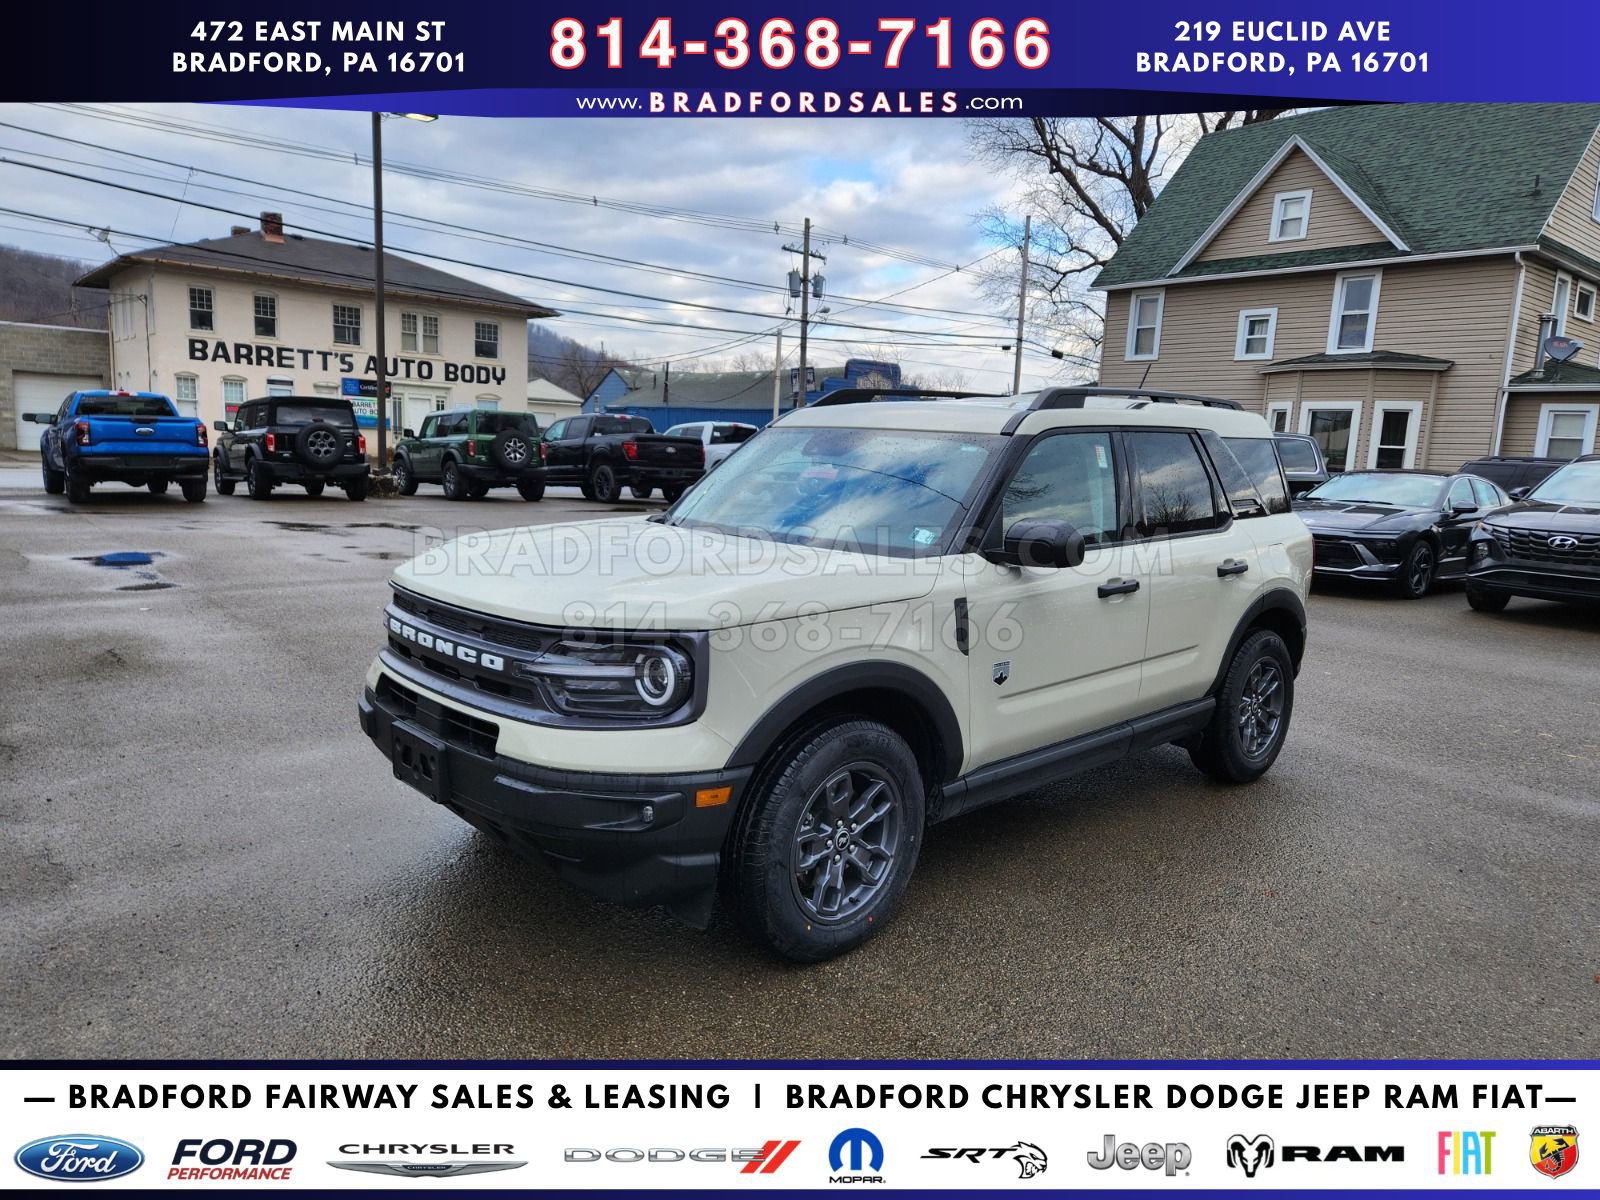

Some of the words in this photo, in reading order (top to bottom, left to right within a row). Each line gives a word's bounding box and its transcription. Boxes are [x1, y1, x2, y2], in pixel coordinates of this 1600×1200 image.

[188, 338, 354, 373] BARRETT'S
[364, 355, 433, 379] AUTO
[444, 362, 506, 385] BODY
[389, 617, 504, 671] BRONCO
